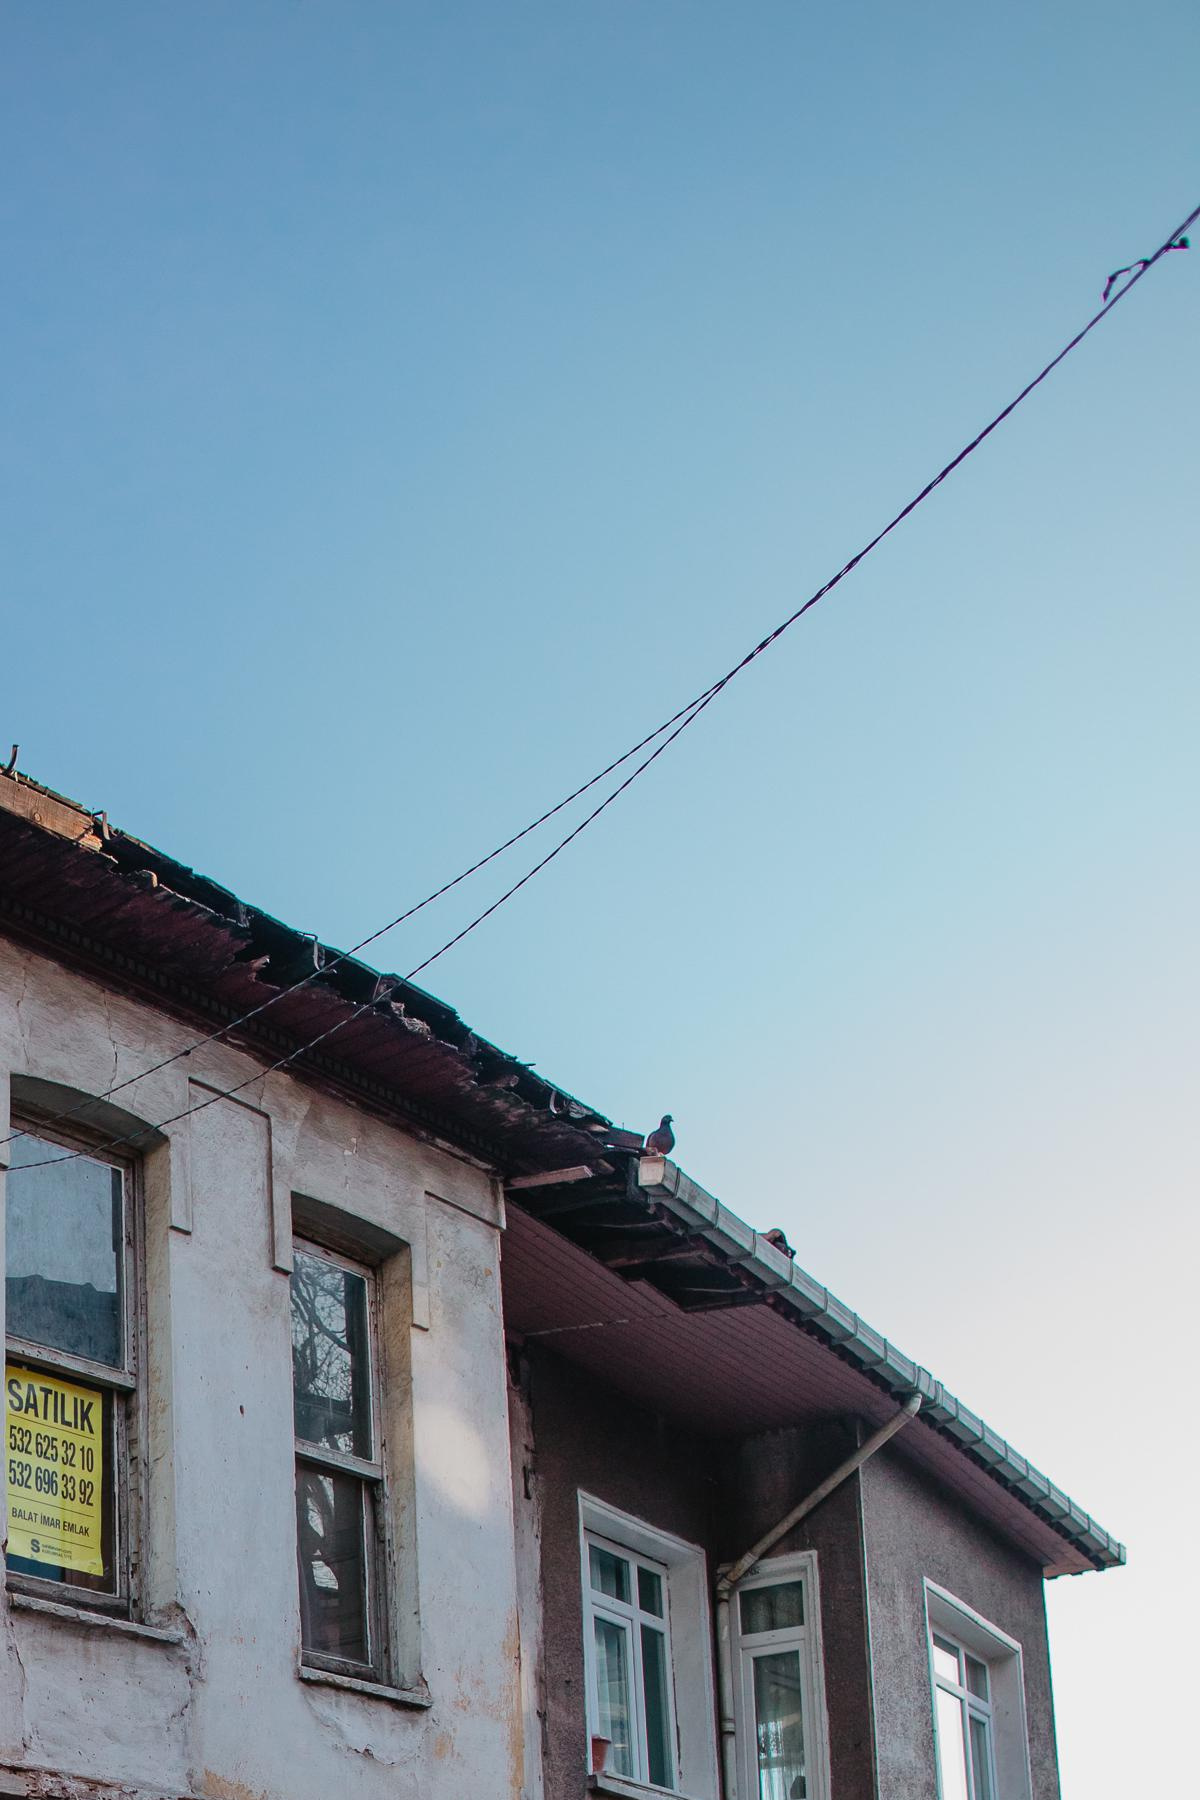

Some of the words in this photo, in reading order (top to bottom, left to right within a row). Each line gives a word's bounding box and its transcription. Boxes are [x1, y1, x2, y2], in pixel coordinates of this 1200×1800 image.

[7, 1379, 94, 1435] SATILIK
[9, 1424, 32, 1455] 532
[35, 1433, 58, 1462] 625
[61, 1440, 76, 1467] 32
[80, 1445, 94, 1472] 10
[9, 1459, 32, 1489] 532
[35, 1466, 58, 1496] 696
[61, 1473, 76, 1501] 33
[79, 1479, 94, 1506] 92
[11, 1507, 39, 1524] BALAT
[40, 1512, 61, 1530] İMAR
[62, 1521, 90, 1537] EMLAK
